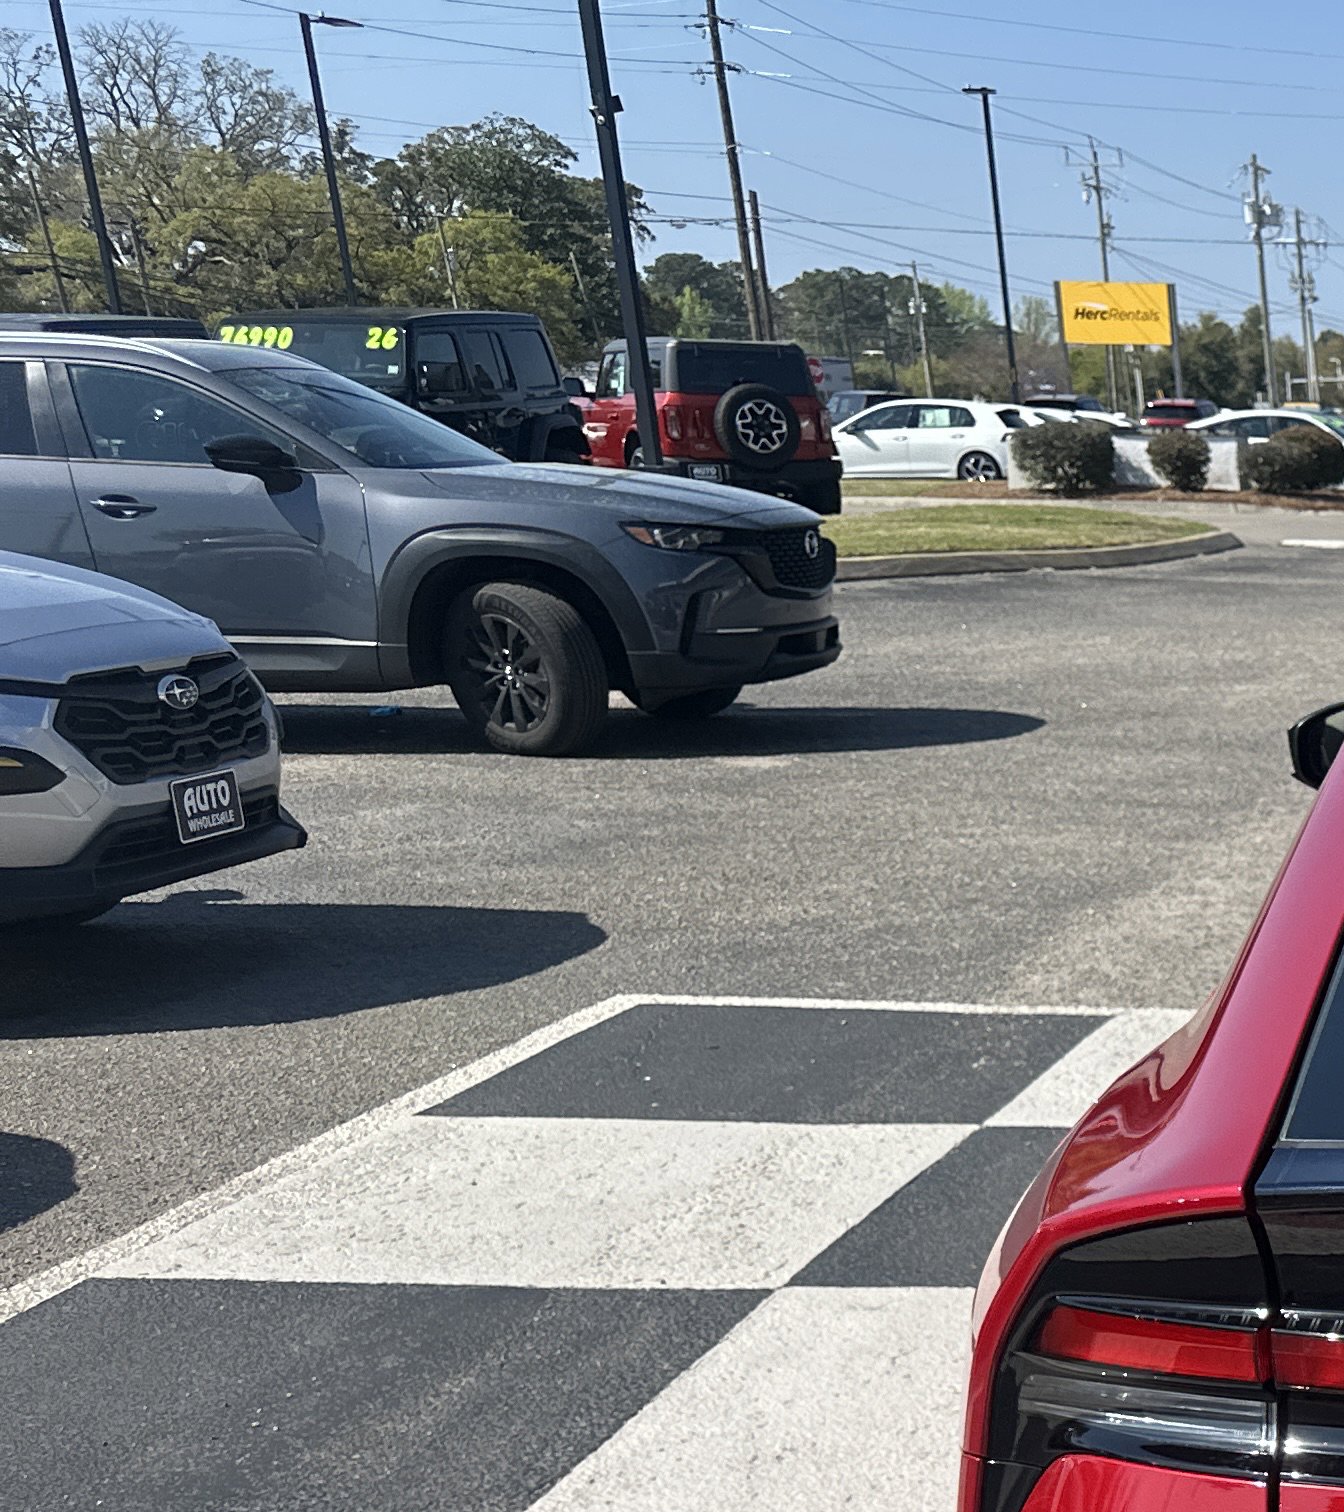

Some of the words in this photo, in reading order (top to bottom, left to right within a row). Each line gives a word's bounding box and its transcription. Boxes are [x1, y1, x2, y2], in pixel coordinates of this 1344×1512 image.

[220, 326, 293, 350] 76990
[366, 327, 398, 349] 26
[183, 779, 231, 818] AUTO
[187, 809, 235, 832] WHOLESALE
